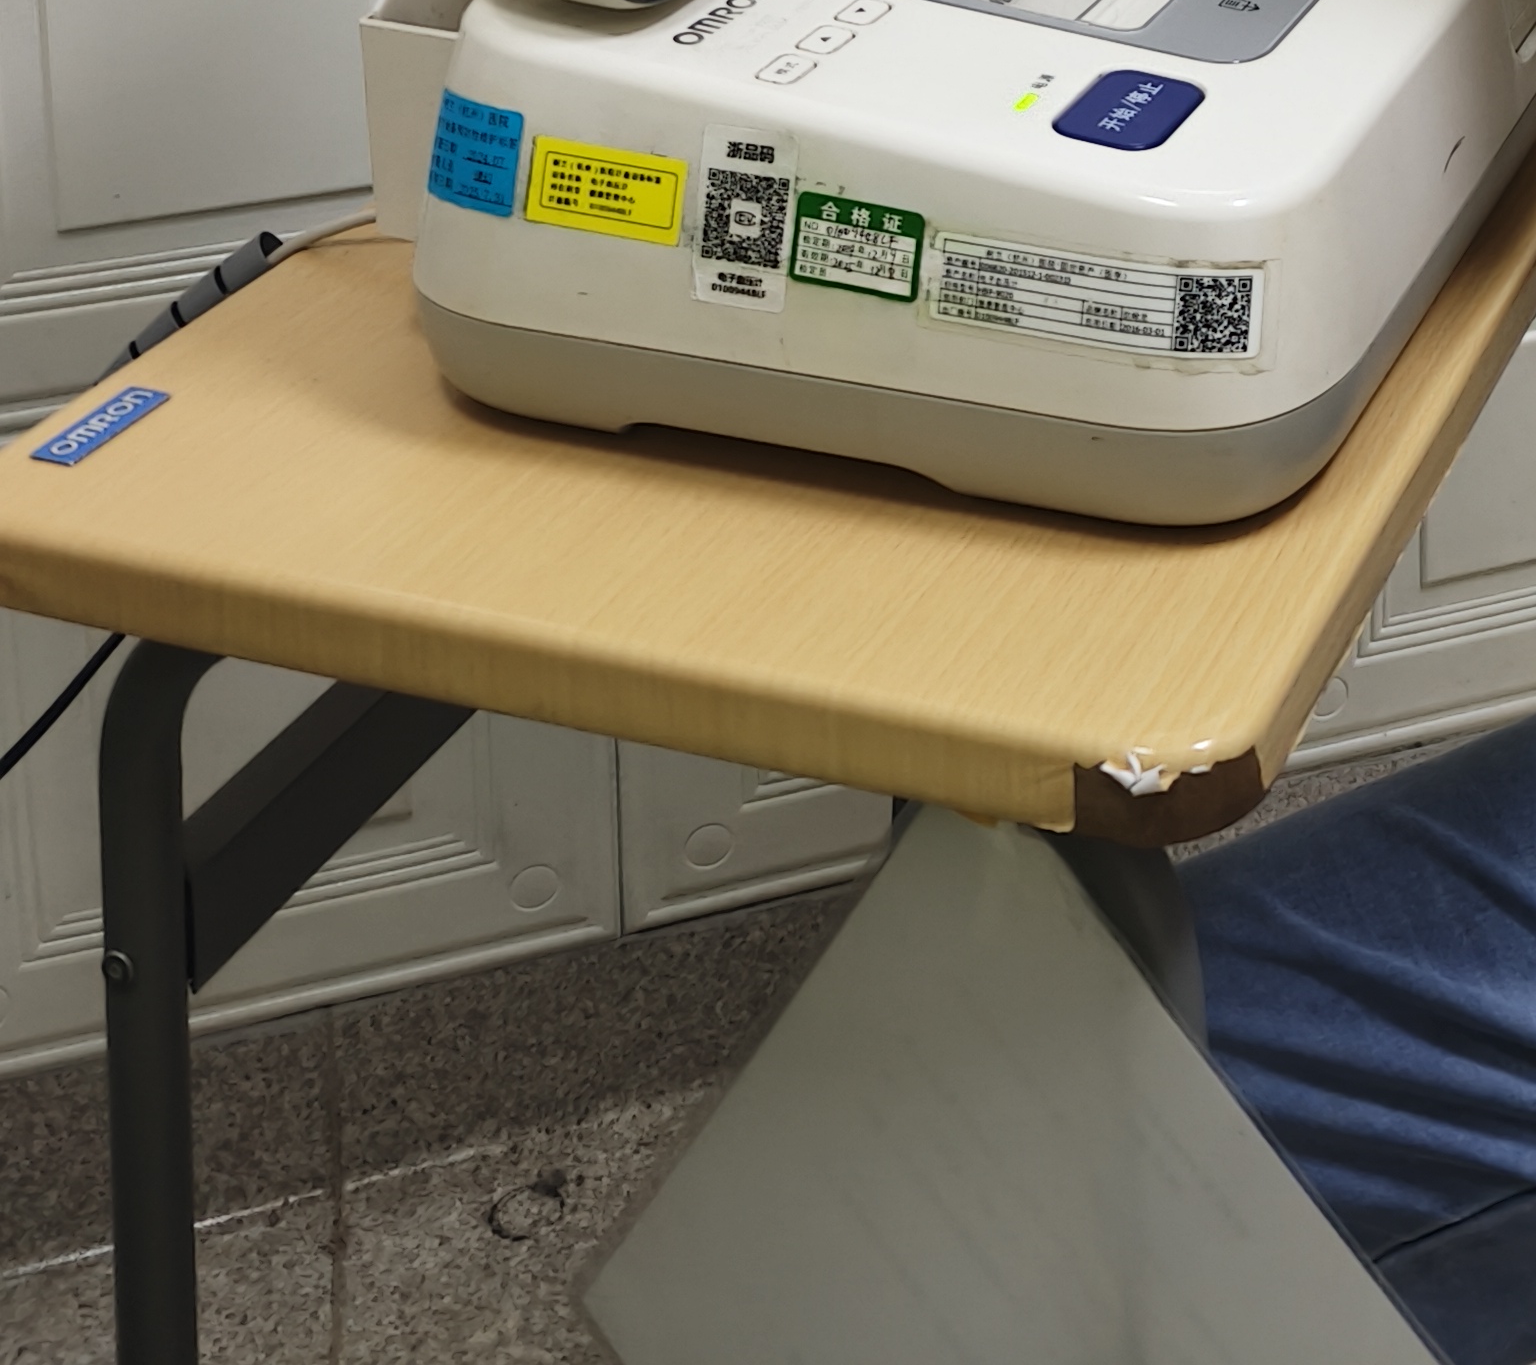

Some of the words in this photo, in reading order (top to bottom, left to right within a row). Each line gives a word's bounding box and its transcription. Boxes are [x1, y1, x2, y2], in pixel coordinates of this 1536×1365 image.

[1097, 81, 1164, 132] 开始/停止
[726, 140, 775, 164] 浙品码
[820, 201, 903, 234] 合格证
[50, 390, 154, 456] OMRON
